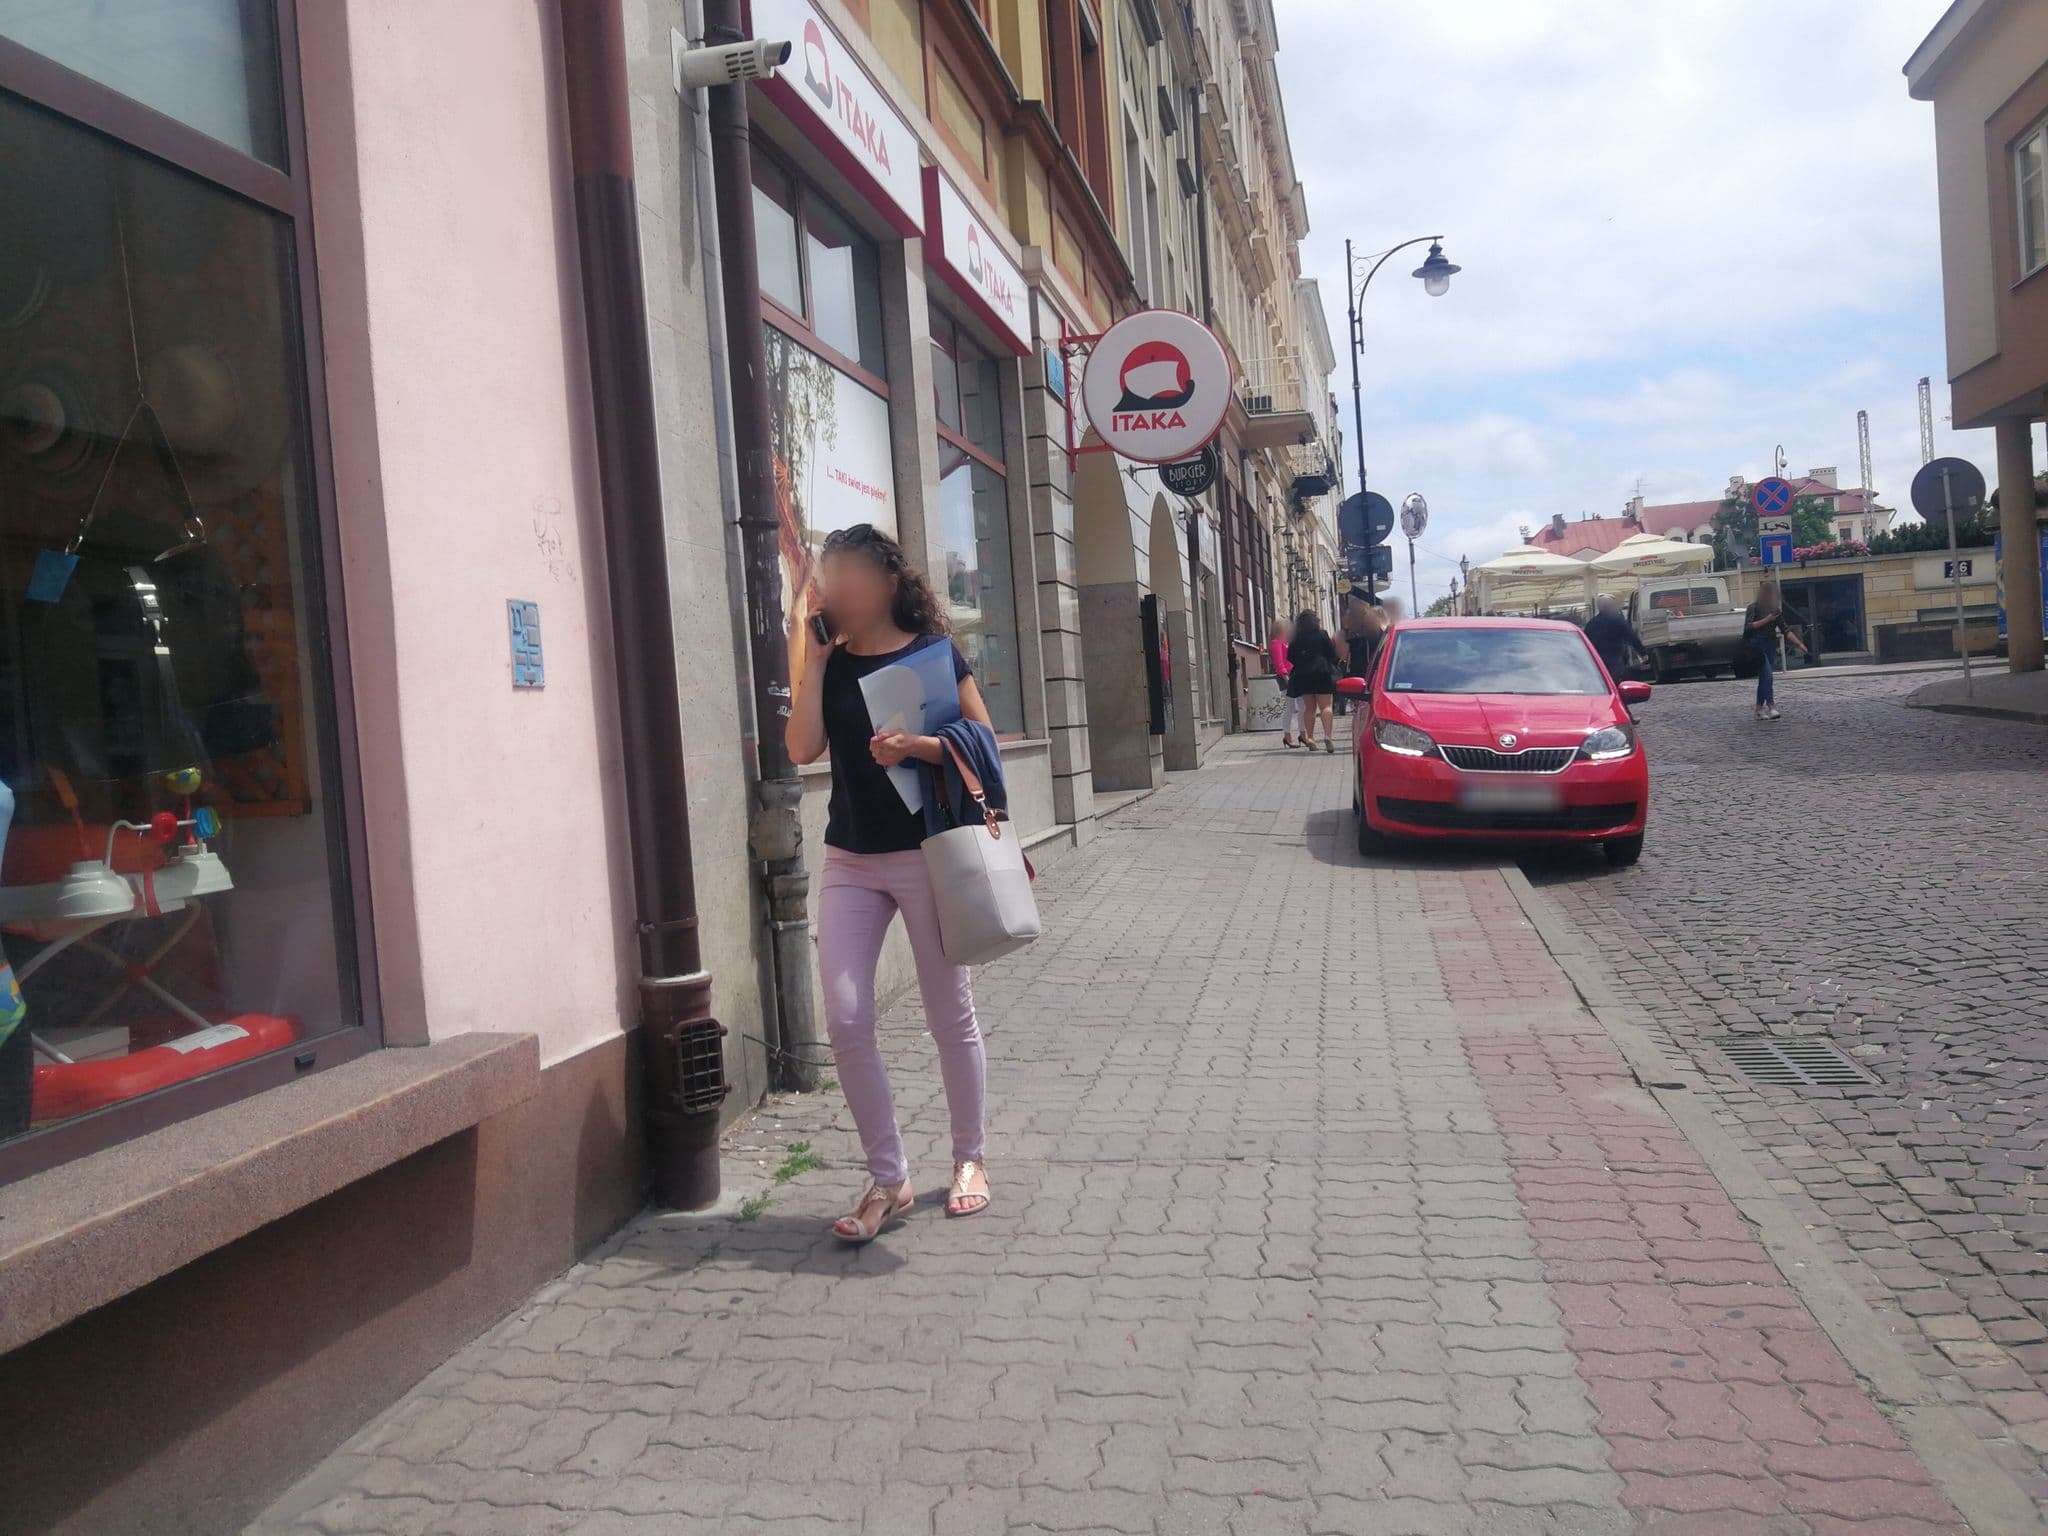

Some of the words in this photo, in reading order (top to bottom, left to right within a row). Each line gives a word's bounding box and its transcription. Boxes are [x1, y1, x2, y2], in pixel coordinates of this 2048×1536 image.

[835, 74, 892, 177] ITAKA
[984, 257, 1014, 318] ITAKA
[1112, 411, 1186, 432] ITAKA
[1169, 463, 1206, 482] BURGER
